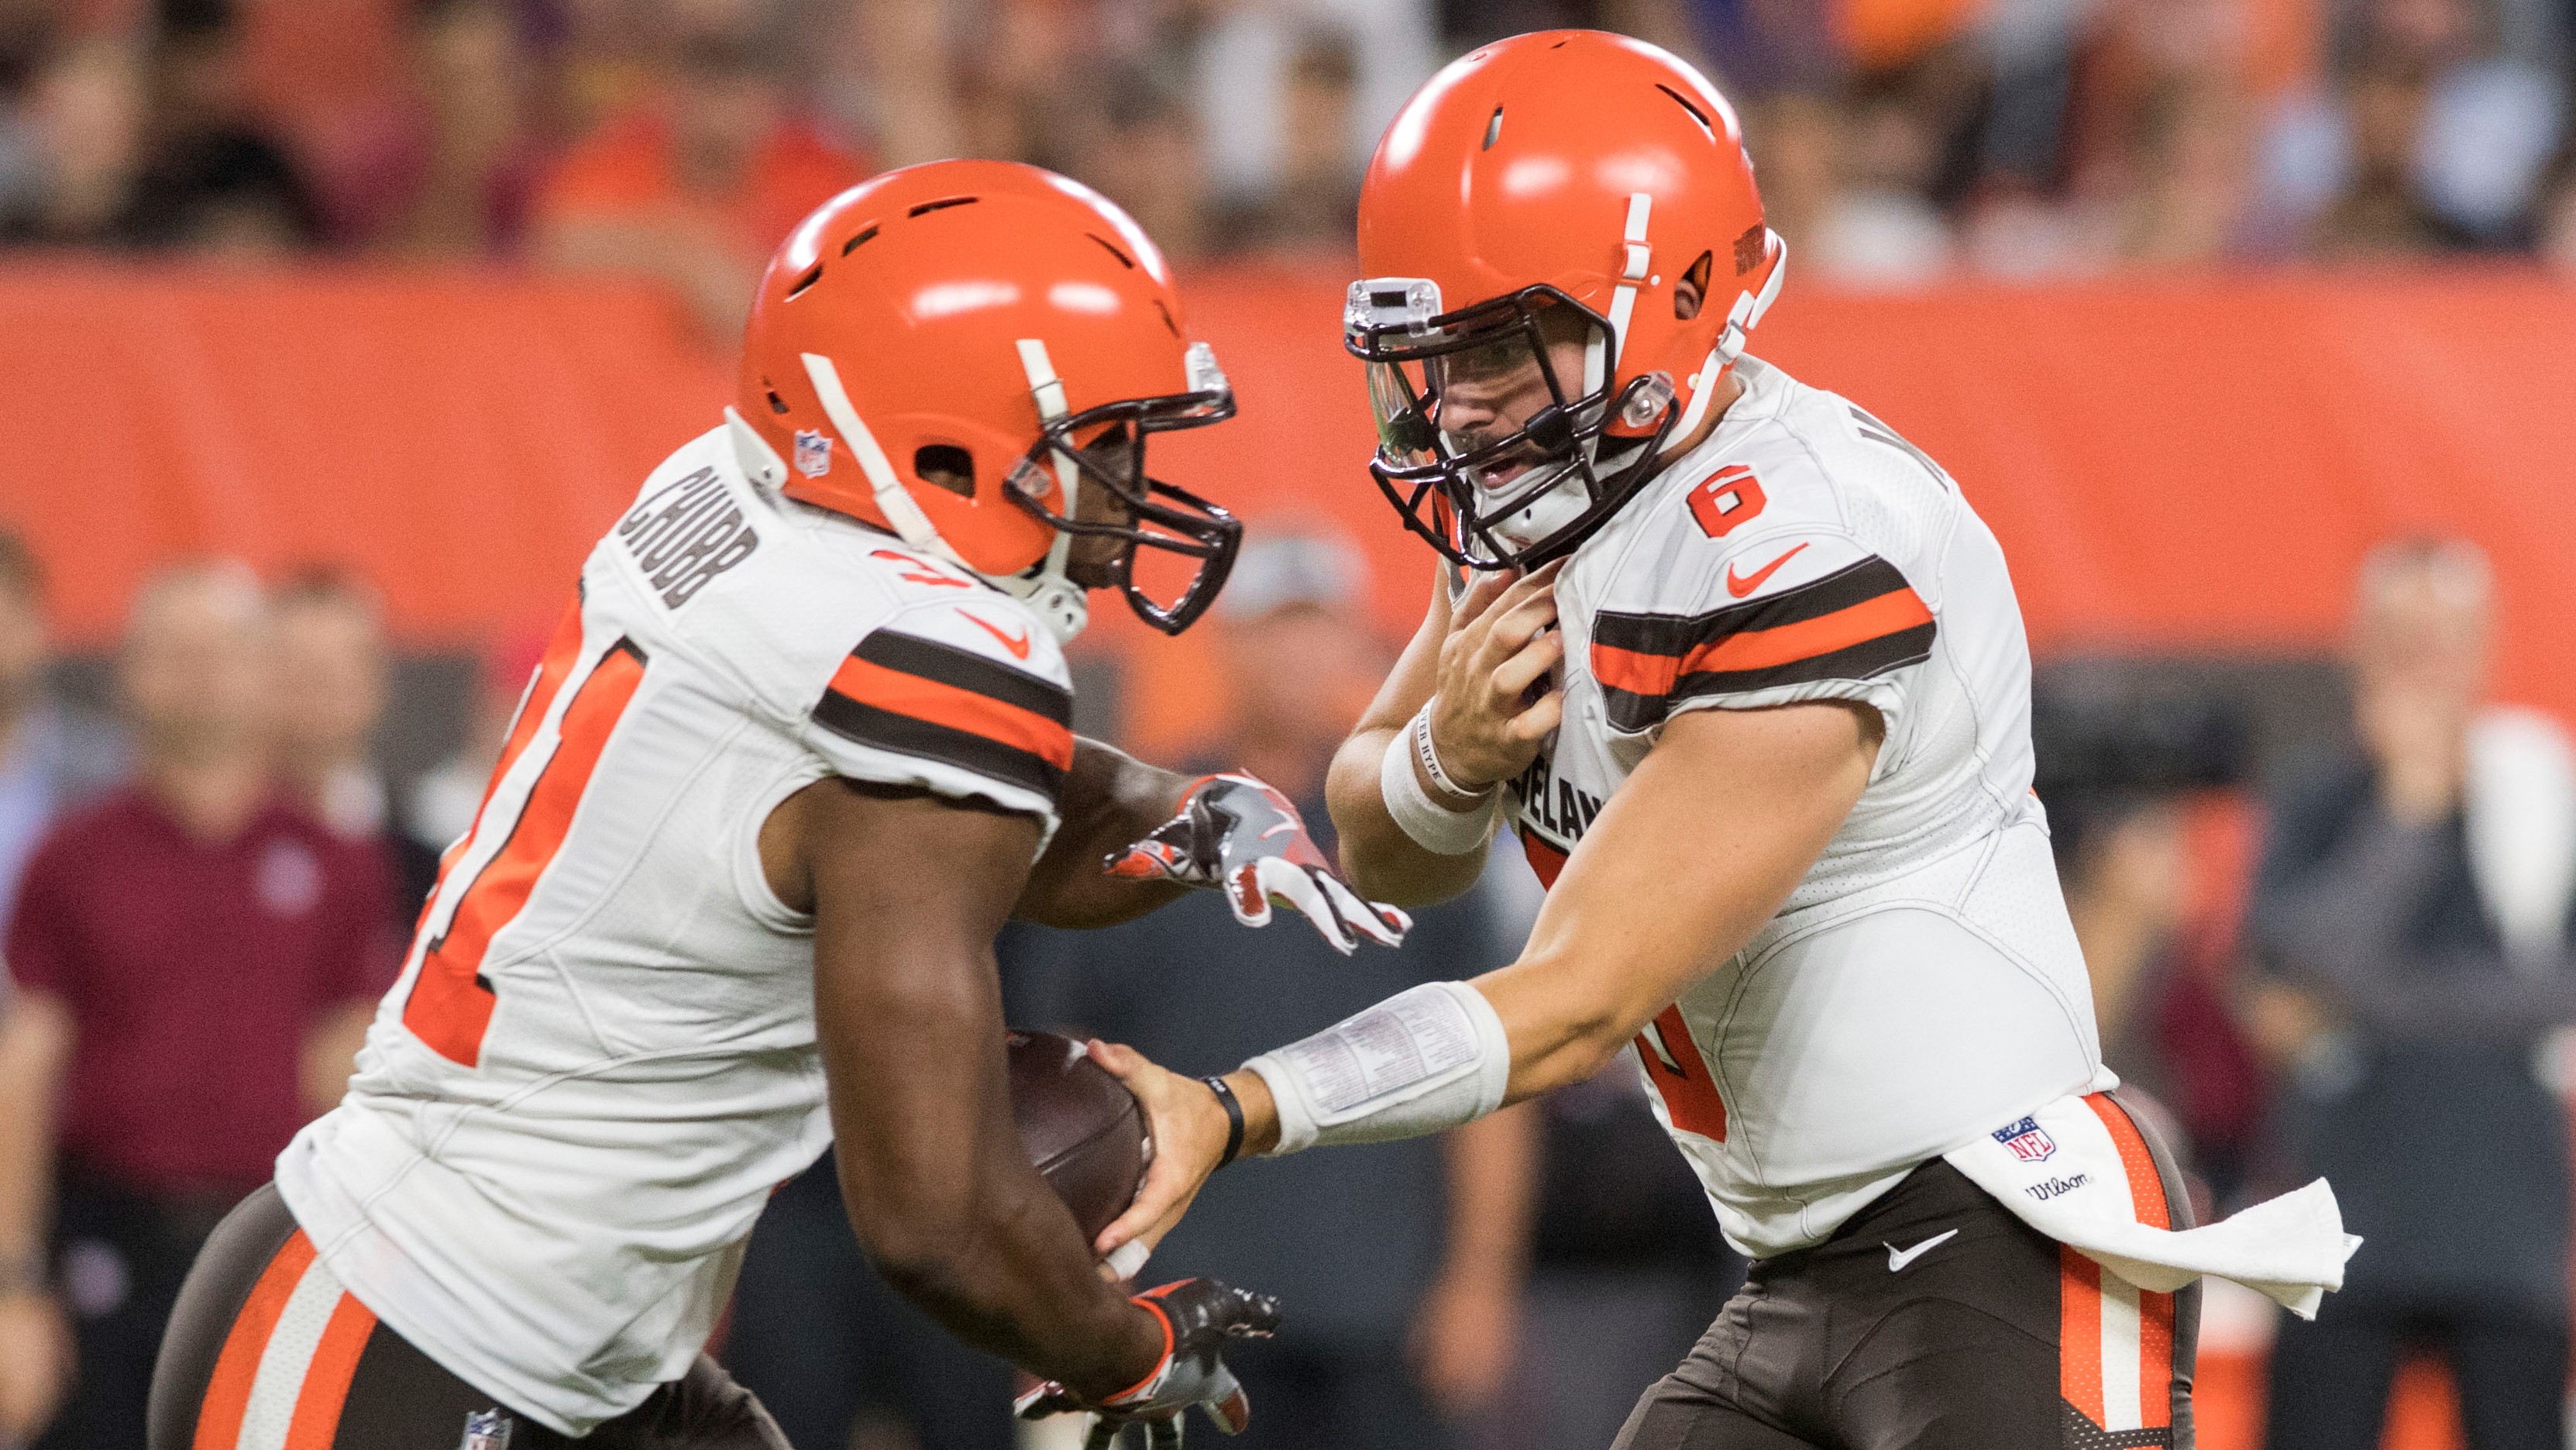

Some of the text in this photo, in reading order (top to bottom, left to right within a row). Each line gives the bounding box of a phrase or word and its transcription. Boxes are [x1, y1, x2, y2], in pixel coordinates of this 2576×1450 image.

[1686, 465, 1767, 538] 6
[618, 466, 759, 611] CHUBB
[1421, 744, 1442, 780] HYPE
[2007, 1132, 2052, 1159] NFL
[2024, 1173, 2090, 1200] Wilson
